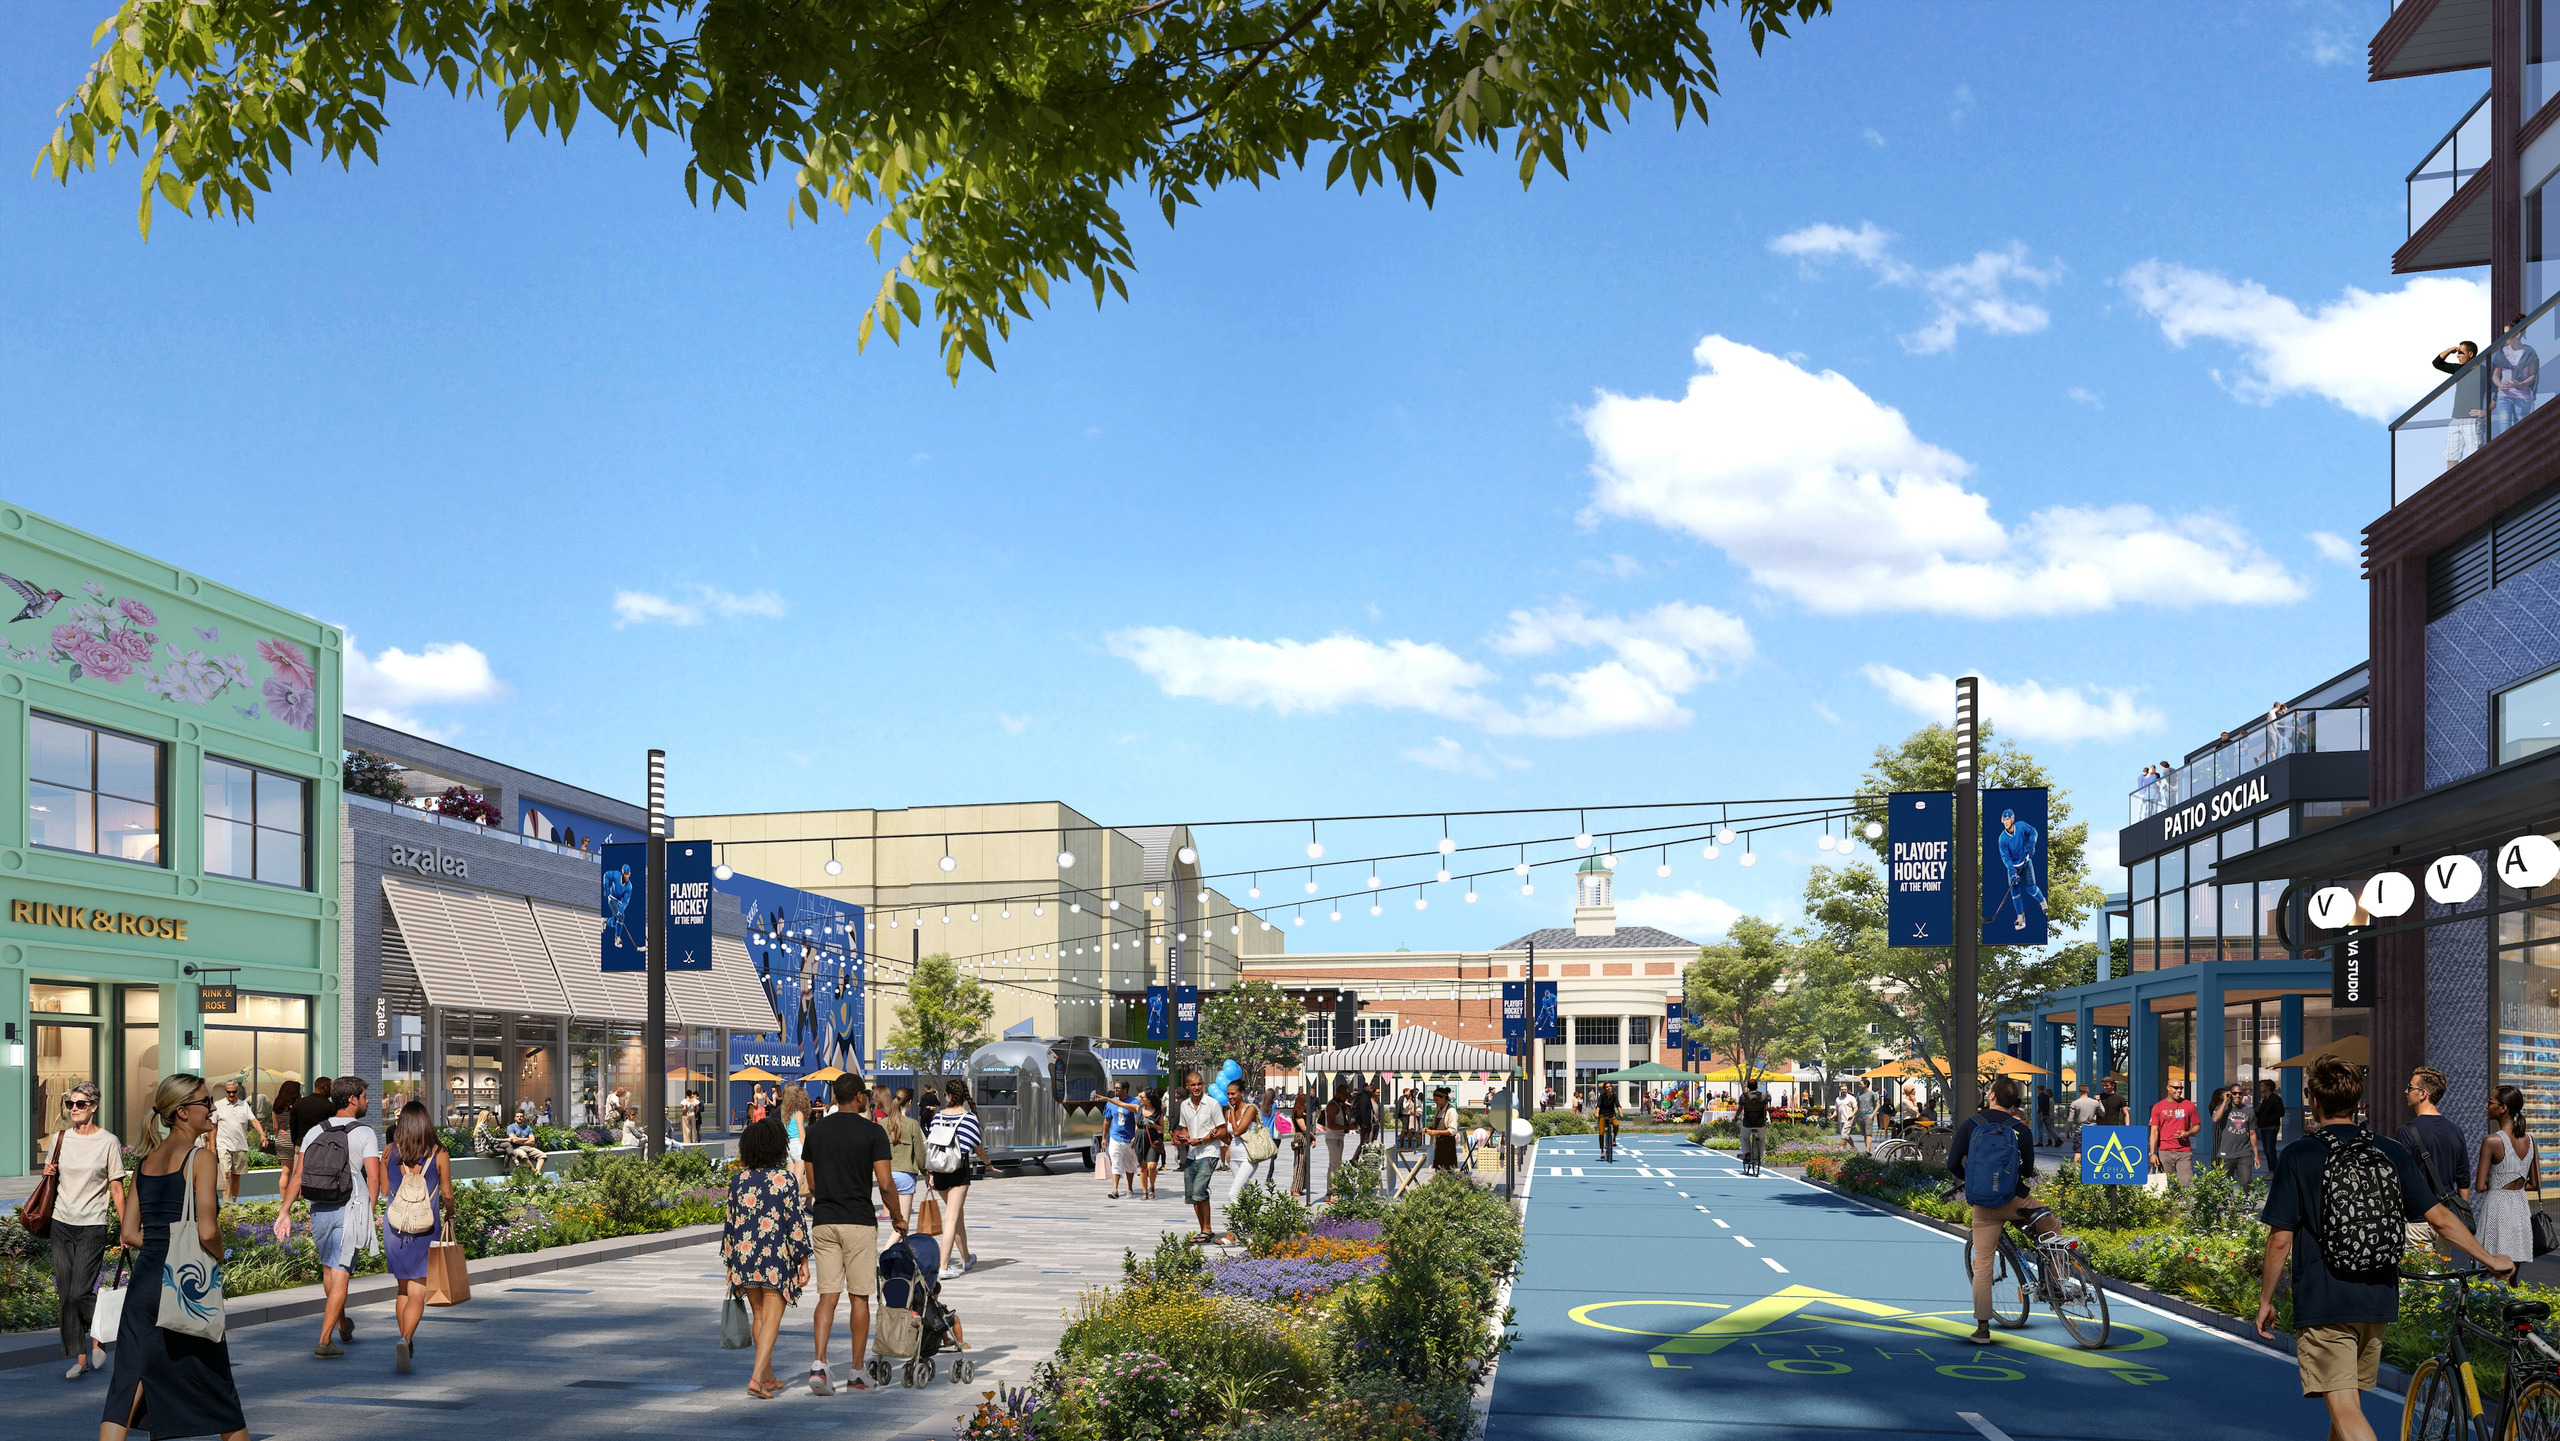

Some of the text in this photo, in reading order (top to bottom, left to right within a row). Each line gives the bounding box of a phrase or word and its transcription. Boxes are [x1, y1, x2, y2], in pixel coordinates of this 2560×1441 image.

[2164, 775, 2269, 841] PATIO SOCIAL
[1894, 841, 1948, 861] PLAYOFF
[391, 844, 469, 878] azalea
[1894, 861, 1948, 881] HOCKEY
[670, 882, 709, 899] PLAYOFF
[1900, 881, 1941, 892] AT THE POINT
[670, 899, 708, 916] HOCKEY
[674, 915, 704, 925] AT THE POINT
[2348, 959, 2359, 1002] STUDIO
[202, 988, 232, 999] RINK &
[205, 1000, 226, 1011] ROSE
[376, 997, 388, 1037] azalea
[743, 1053, 801, 1067] SKATE & BAKE
[2093, 1172, 2135, 1180] LOOP
[1649, 1353, 2170, 1386] LOOP
